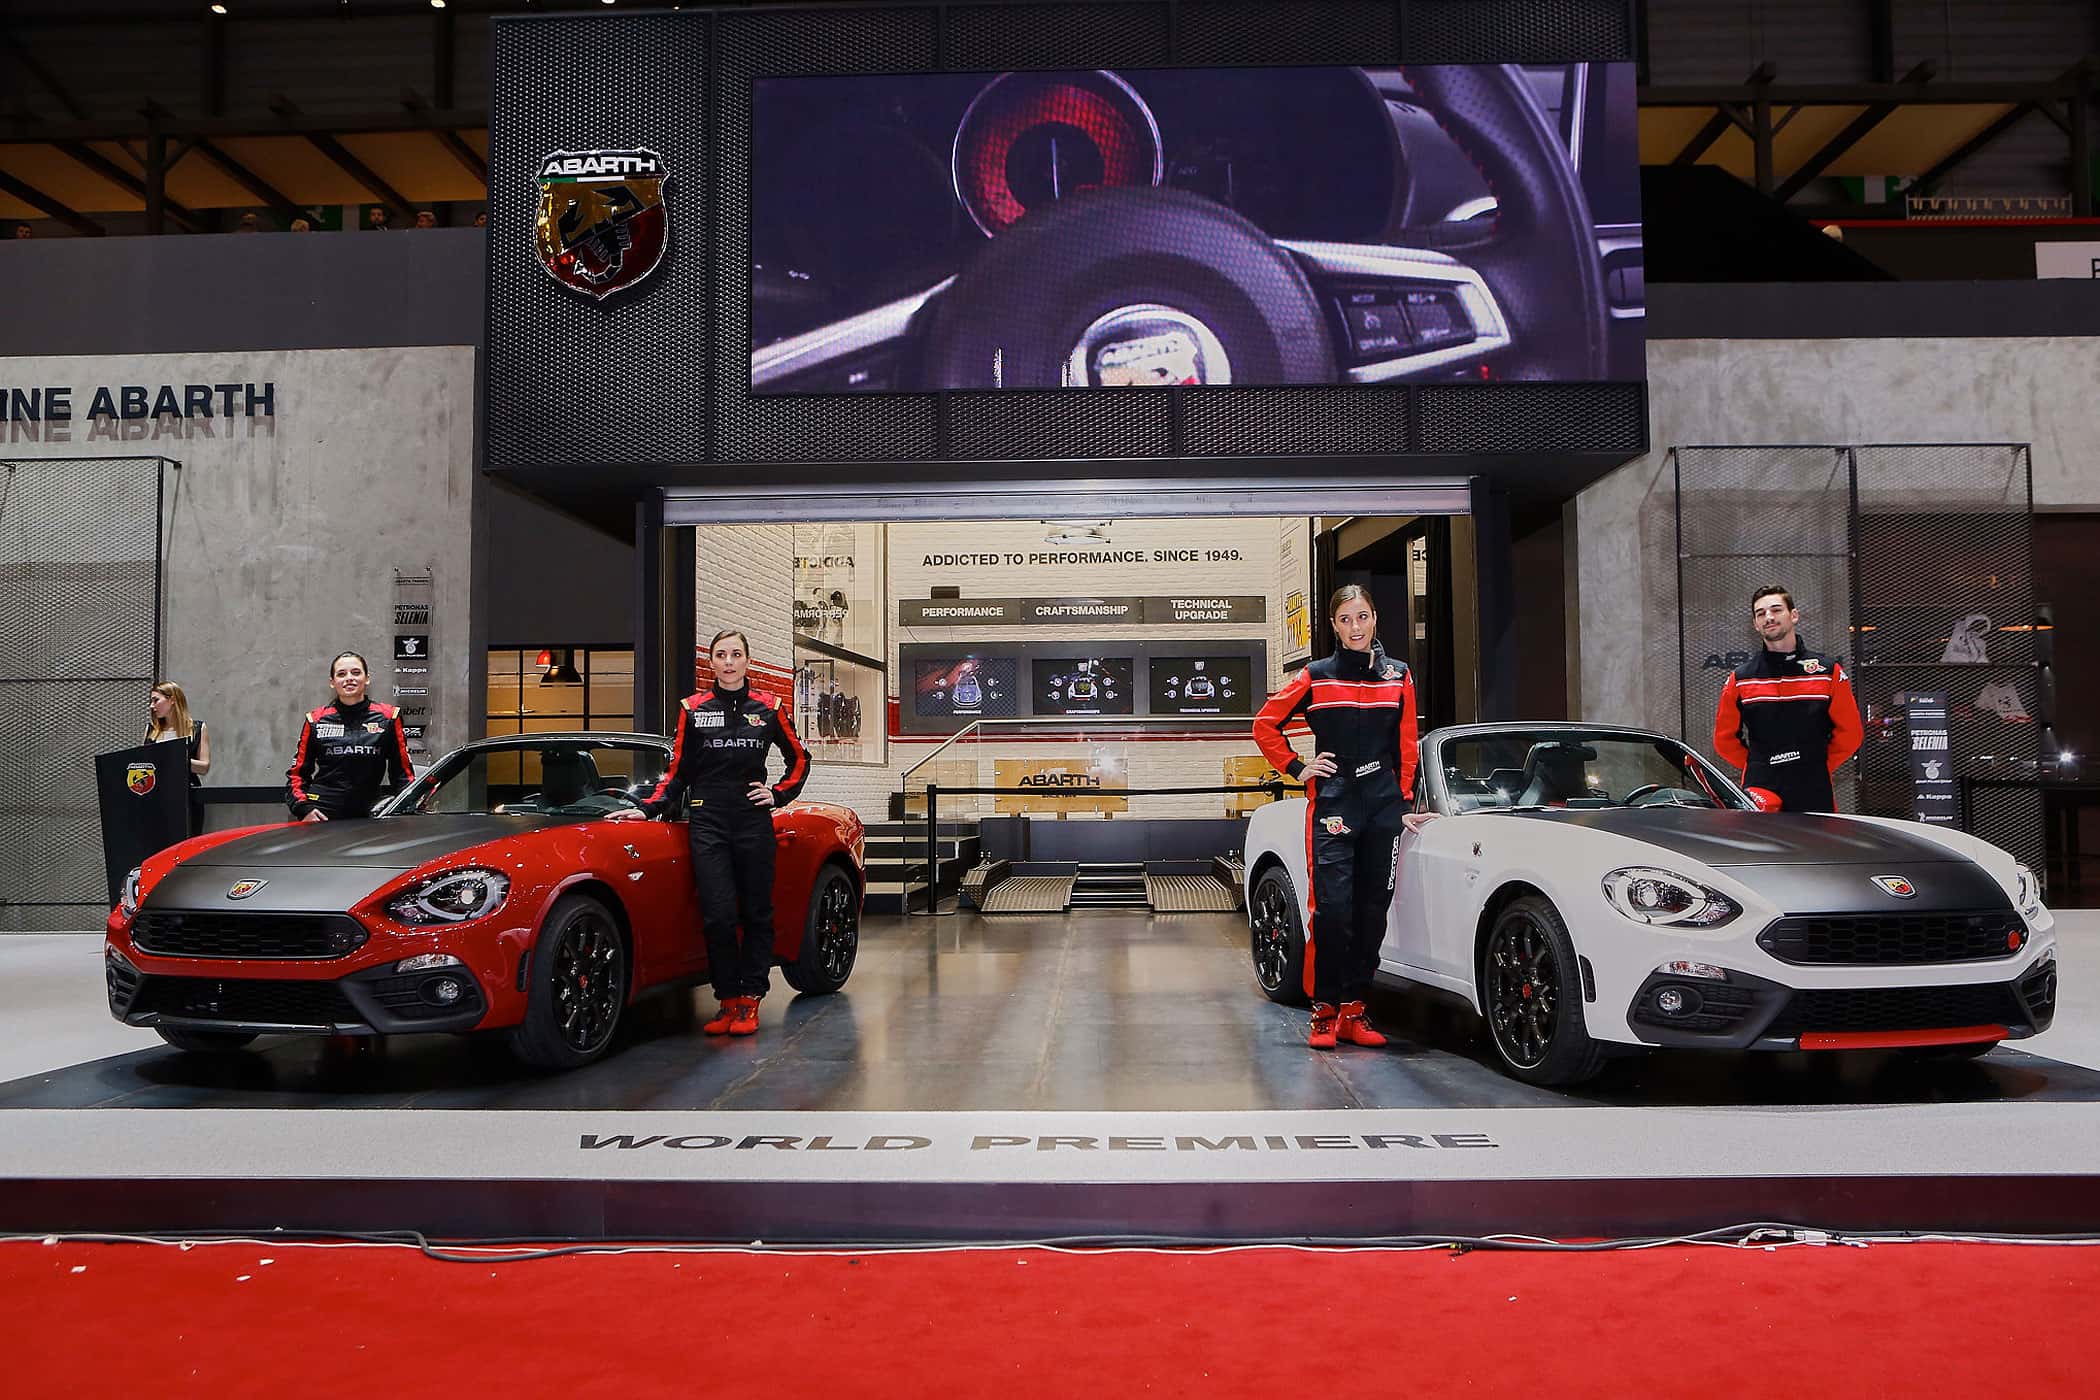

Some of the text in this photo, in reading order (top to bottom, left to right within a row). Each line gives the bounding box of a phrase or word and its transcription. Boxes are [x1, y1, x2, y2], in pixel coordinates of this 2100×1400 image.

[543, 156, 656, 175] ABARTH
[87, 382, 274, 420] ABARTH
[922, 550, 1243, 567] ADDICTED TO PERFORMANCE. SINCE 1949.
[1035, 605, 1129, 616] CRAFTSMANSHIP
[1170, 600, 1232, 609] TECHNICAL
[394, 611, 429, 625] SELENIA
[922, 607, 1004, 617] PERFORMANCE
[1175, 610, 1228, 620] UPGRADE
[703, 738, 765, 749] ABARTH
[1911, 736, 1948, 750] SELENIA
[325, 745, 381, 756] ABARTH
[1018, 774, 1100, 786] ABARTH
[579, 1134, 1499, 1151] WORLD PREMIERE
